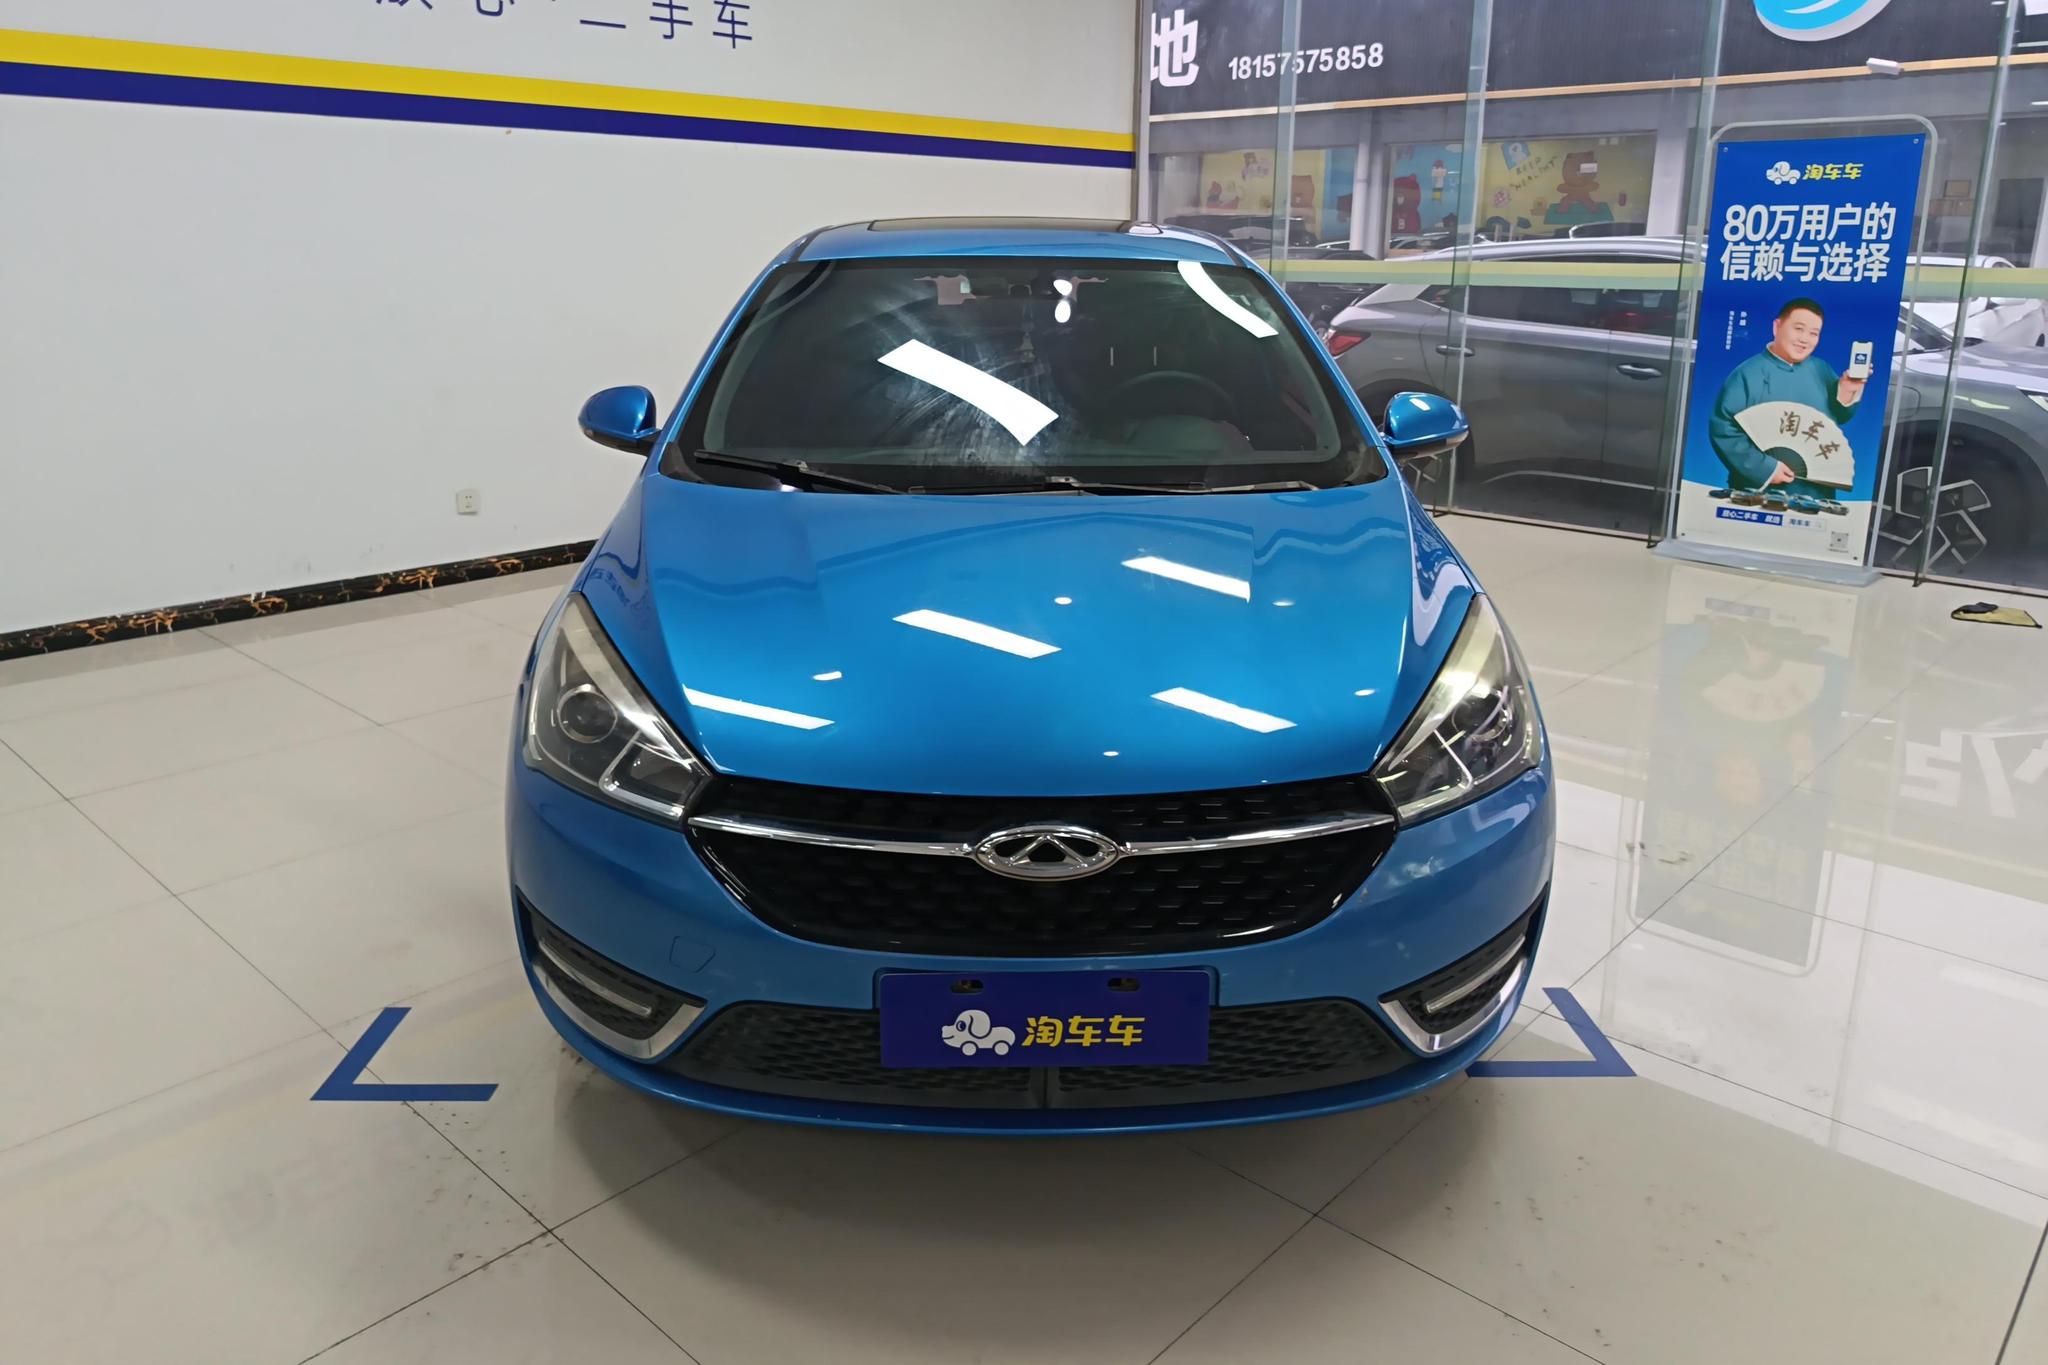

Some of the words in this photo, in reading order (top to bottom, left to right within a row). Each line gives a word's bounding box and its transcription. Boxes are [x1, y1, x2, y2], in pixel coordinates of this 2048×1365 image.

[1228, 42, 1384, 80] 18157575858
[1802, 162, 1864, 181] 淘车车
[1723, 201, 1897, 242] 80万用户的
[1720, 242, 1891, 284] 信赖与选择
[1780, 411, 1840, 459] 淘车车
[1021, 1014, 1146, 1047] 淘车车
